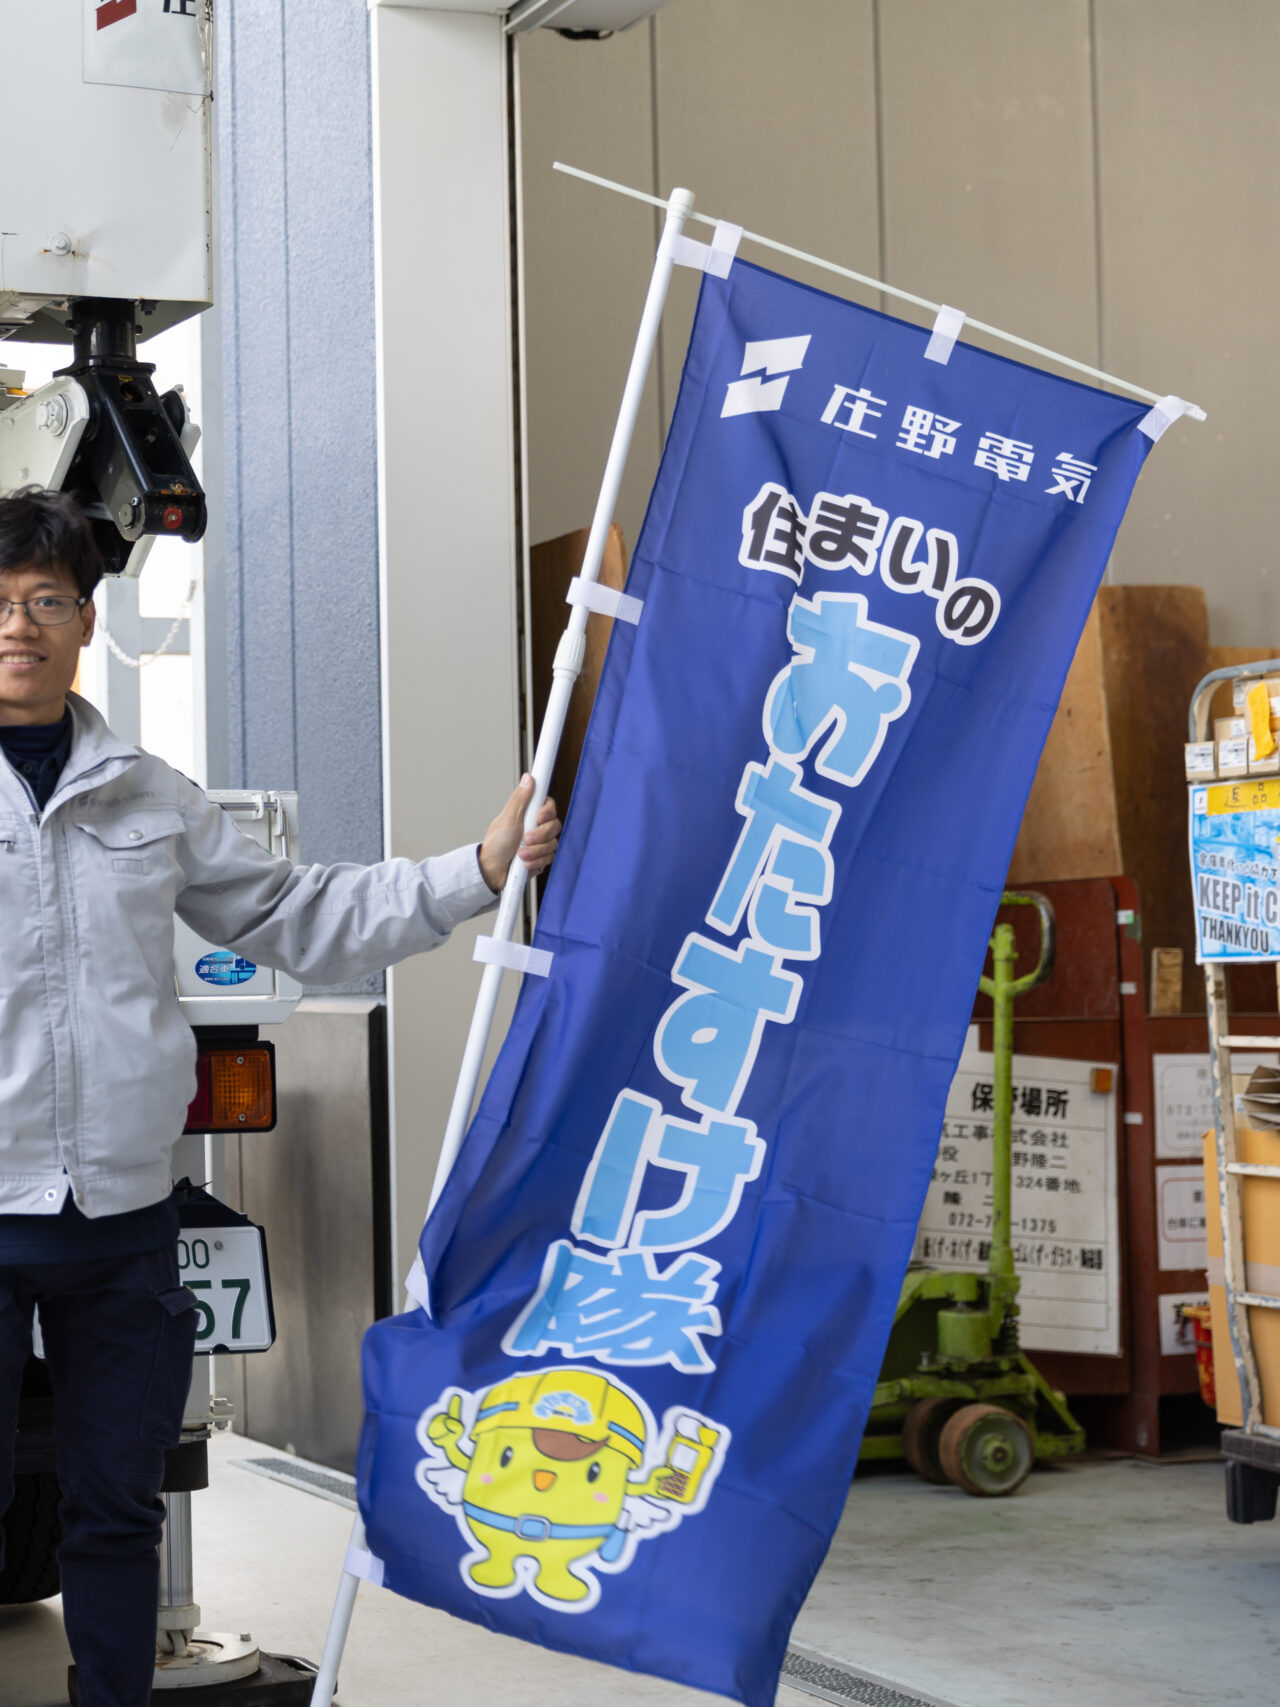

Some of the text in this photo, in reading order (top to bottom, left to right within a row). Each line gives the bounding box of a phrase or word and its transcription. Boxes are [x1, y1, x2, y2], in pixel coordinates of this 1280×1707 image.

[820, 383, 1098, 504] 庄野電気
[738, 481, 1001, 646] 住まいの
[1199, 875, 1242, 915] KEEP
[1246, 886, 1261, 920] it
[1201, 915, 1270, 954] THANKYOU
[970, 1083, 1070, 1119] 保場所
[942, 1122, 1069, 1149] 工事式会社
